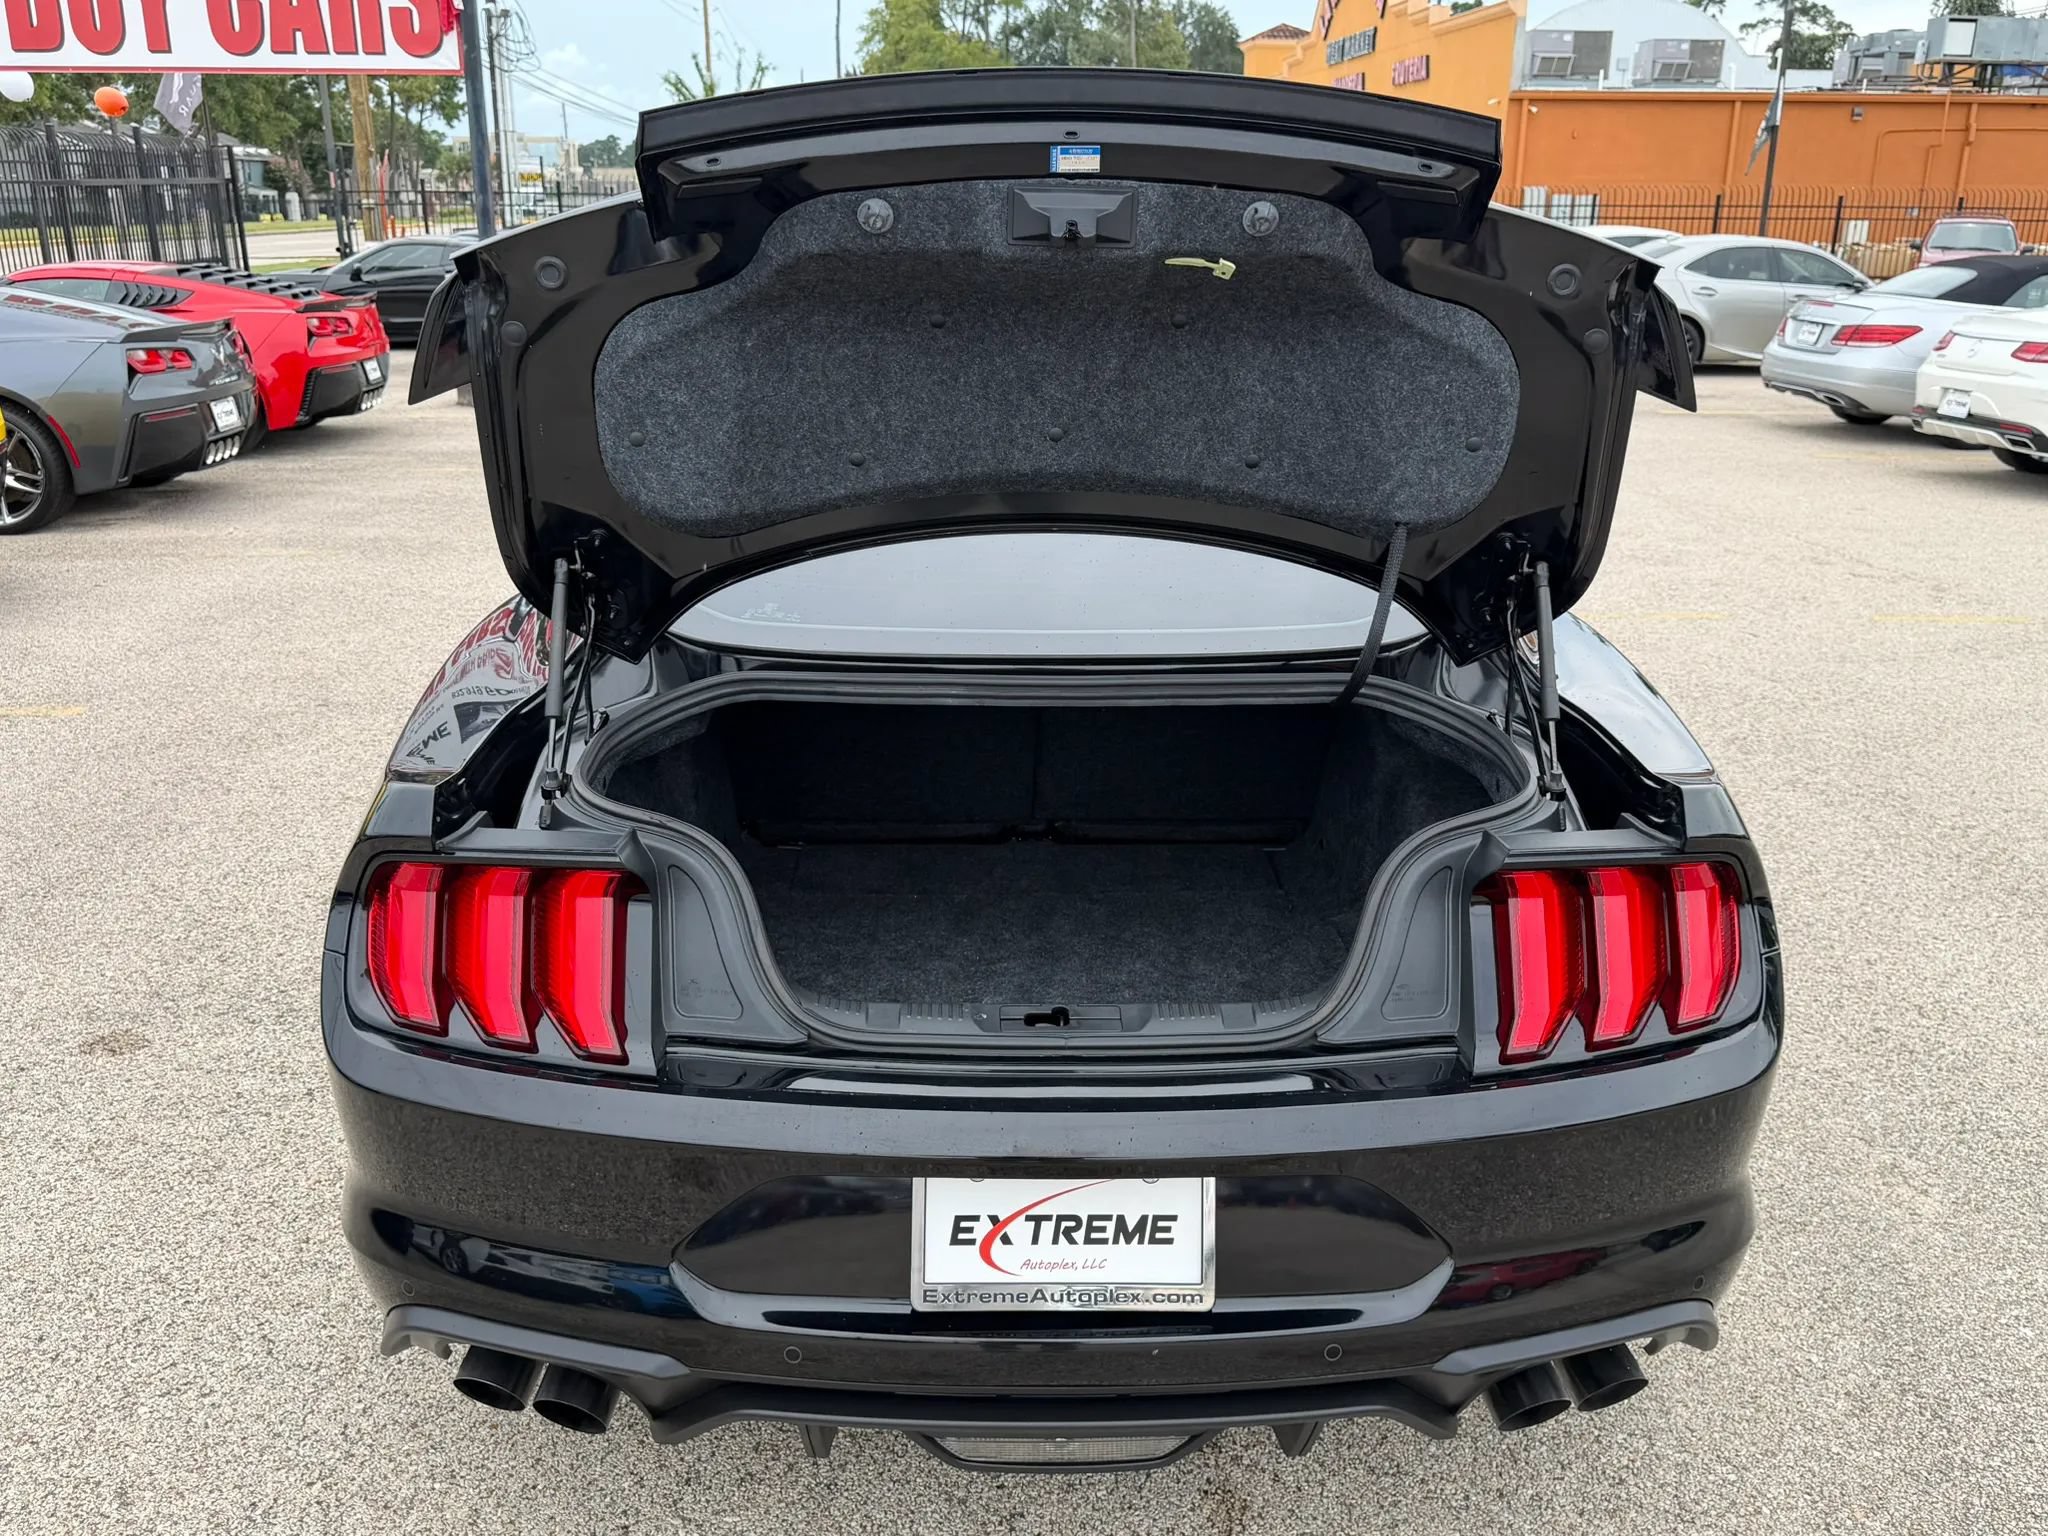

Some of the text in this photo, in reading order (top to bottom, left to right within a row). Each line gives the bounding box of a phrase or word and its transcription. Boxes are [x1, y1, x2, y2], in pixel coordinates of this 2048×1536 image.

[949, 1214, 1178, 1246] EXTREME
[1020, 1258, 1108, 1273] Autoplex, LLC
[922, 1287, 1204, 1306] ExtremeAutoplex.com
